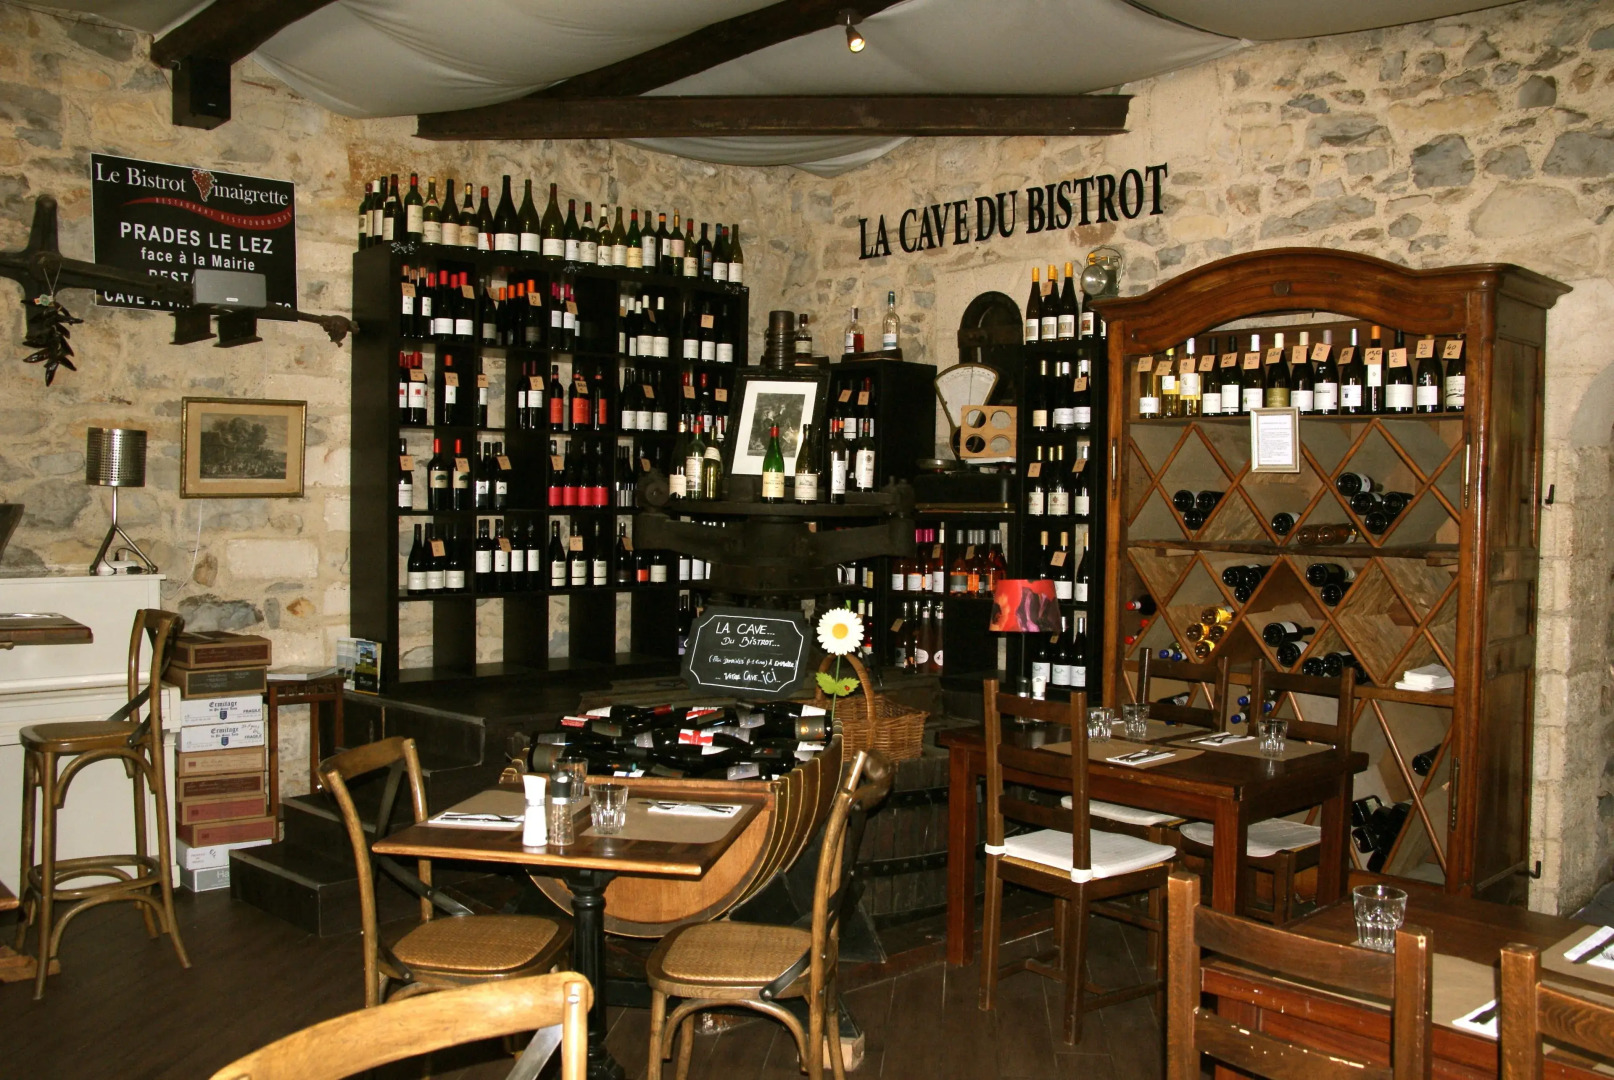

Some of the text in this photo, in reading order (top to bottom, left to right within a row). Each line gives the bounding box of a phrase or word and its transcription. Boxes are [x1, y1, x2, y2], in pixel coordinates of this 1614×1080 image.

[95, 162, 120, 184] Le
[126, 166, 188, 193] Bistrot
[155, 197, 215, 217] RESTAURANT
[858, 162, 1168, 260] LA CAVE DU BISTROT
[120, 221, 274, 255] PRADES LE LEZ
[141, 247, 256, 271] face à la Mairie
[715, 621, 731, 635] LA
[210, 727, 239, 735] Ermitage
